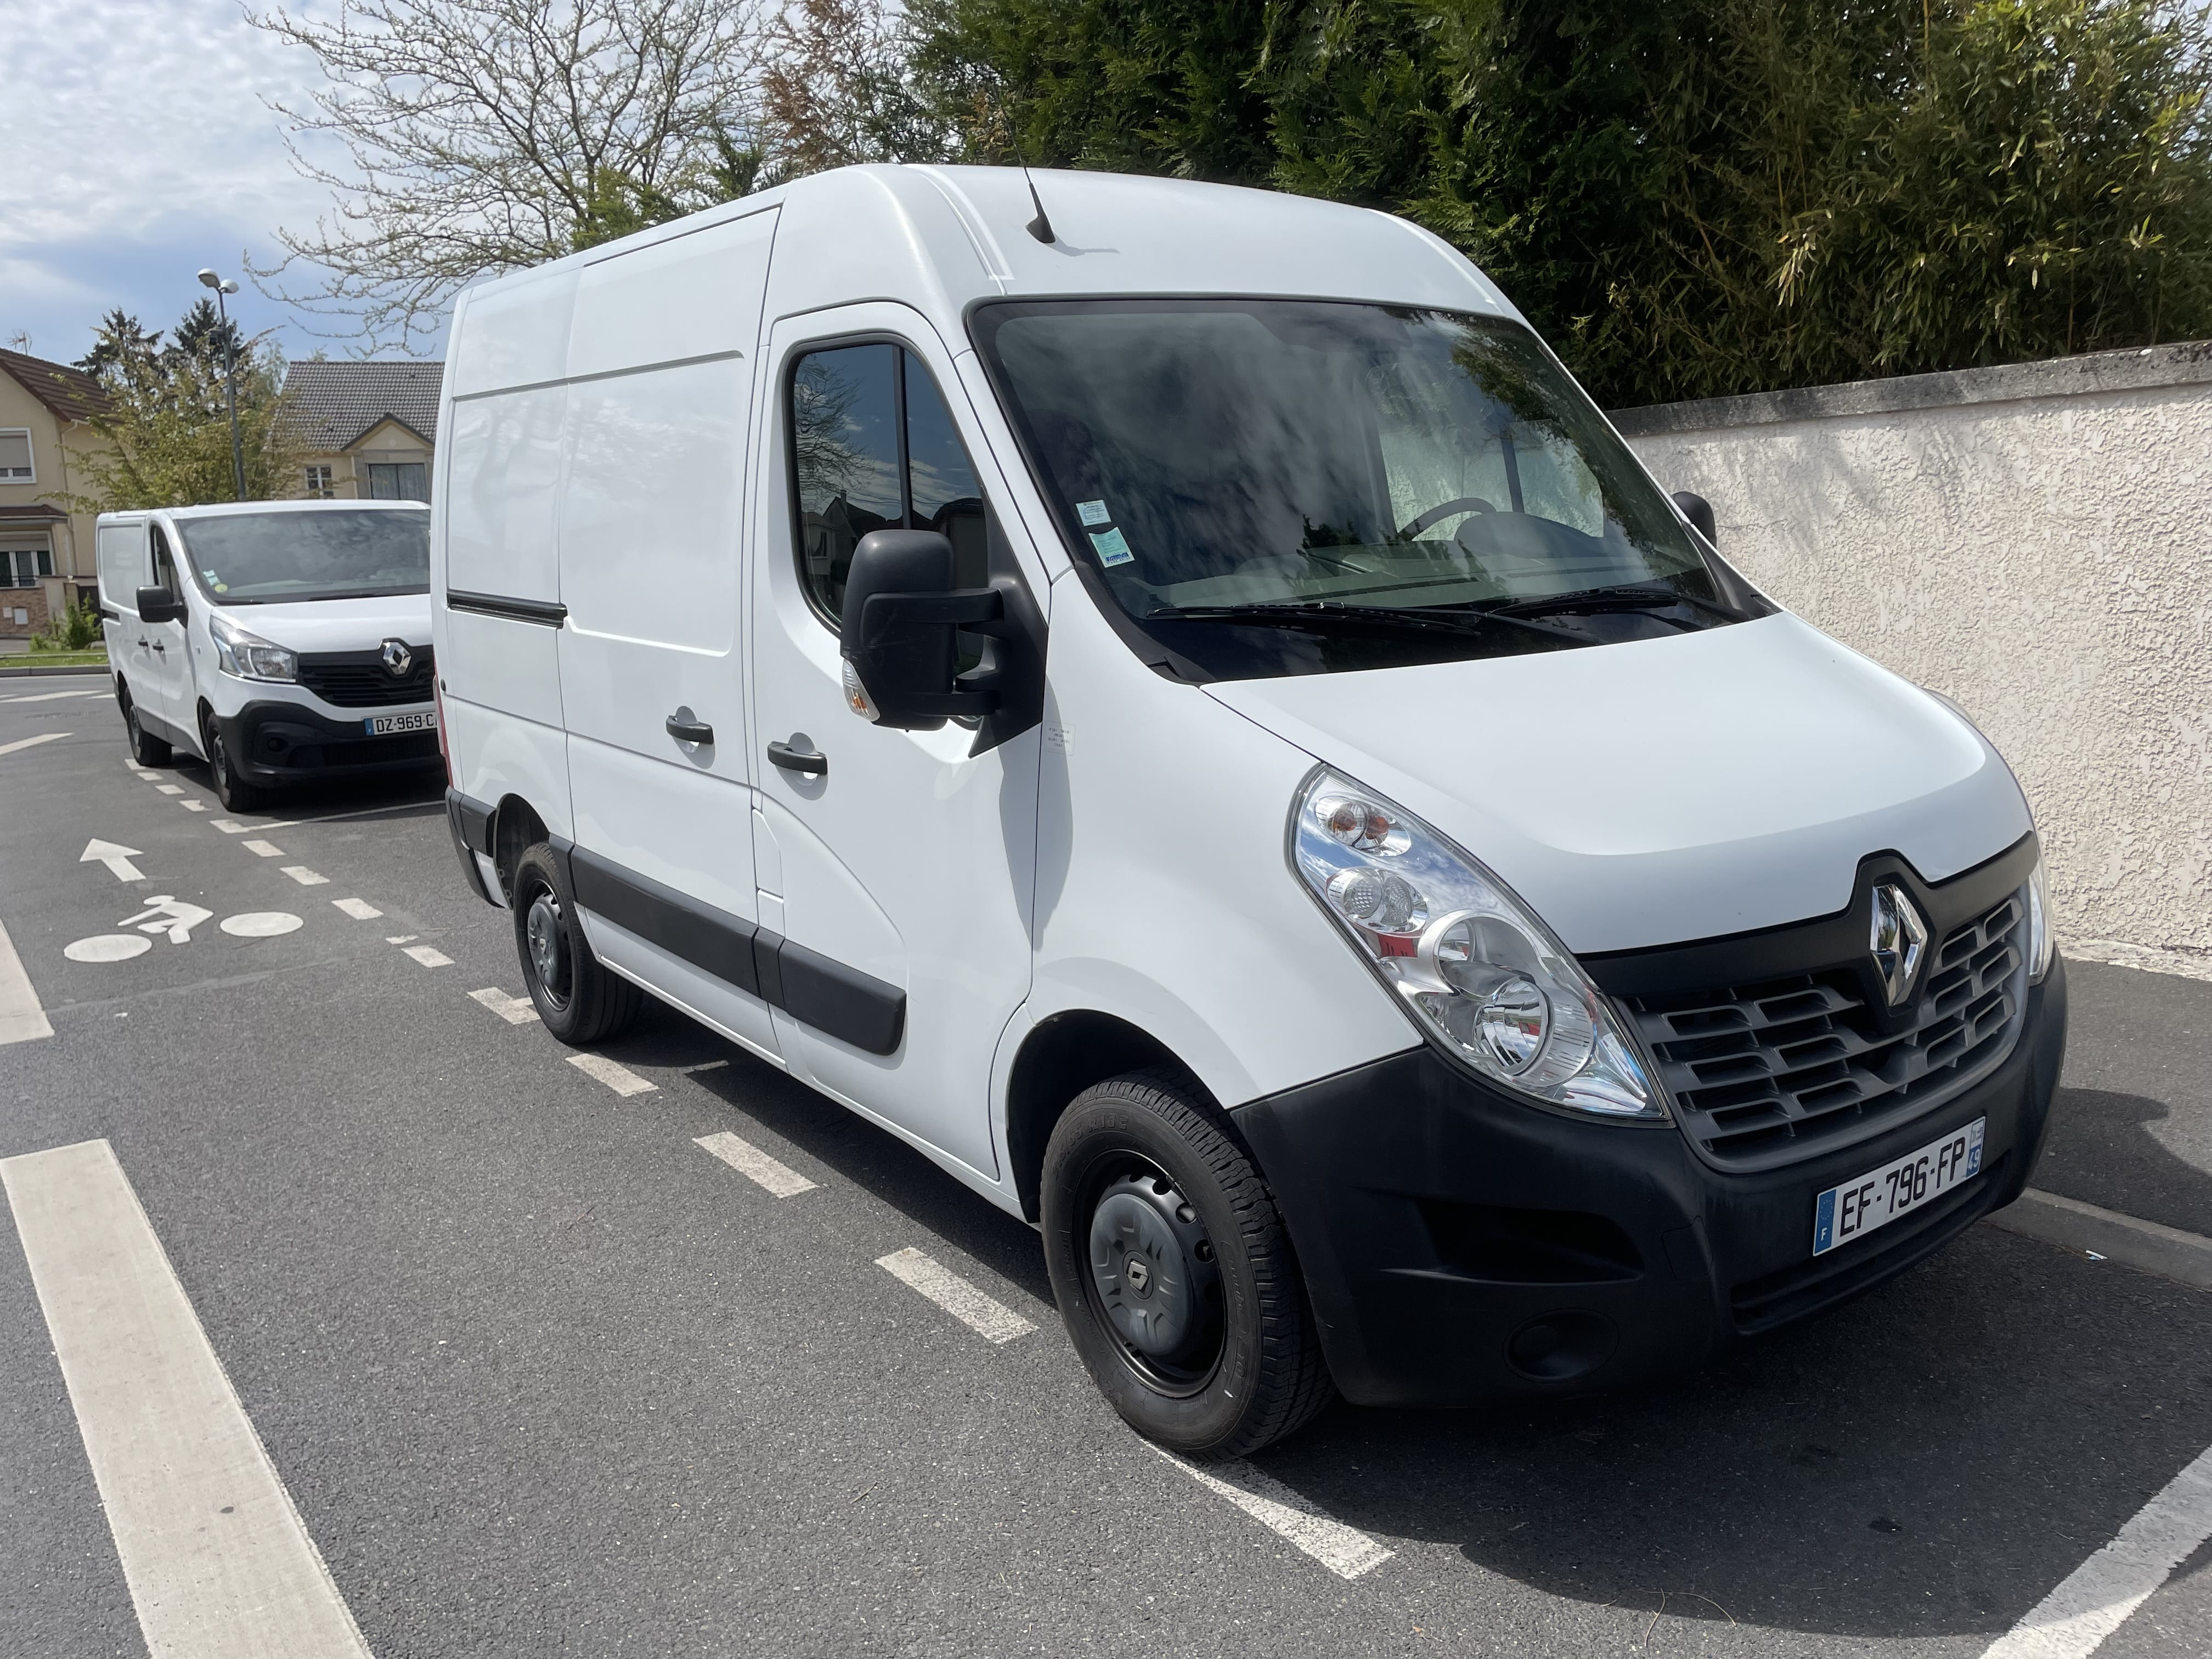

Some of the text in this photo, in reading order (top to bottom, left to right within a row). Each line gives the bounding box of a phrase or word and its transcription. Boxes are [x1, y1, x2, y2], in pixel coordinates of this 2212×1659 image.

[376, 714, 437, 732] DZ-969-C
[1968, 1148, 1980, 1171] 49
[1839, 1136, 1965, 1237] EF-796-FP
[1820, 1227, 1827, 1242] F
